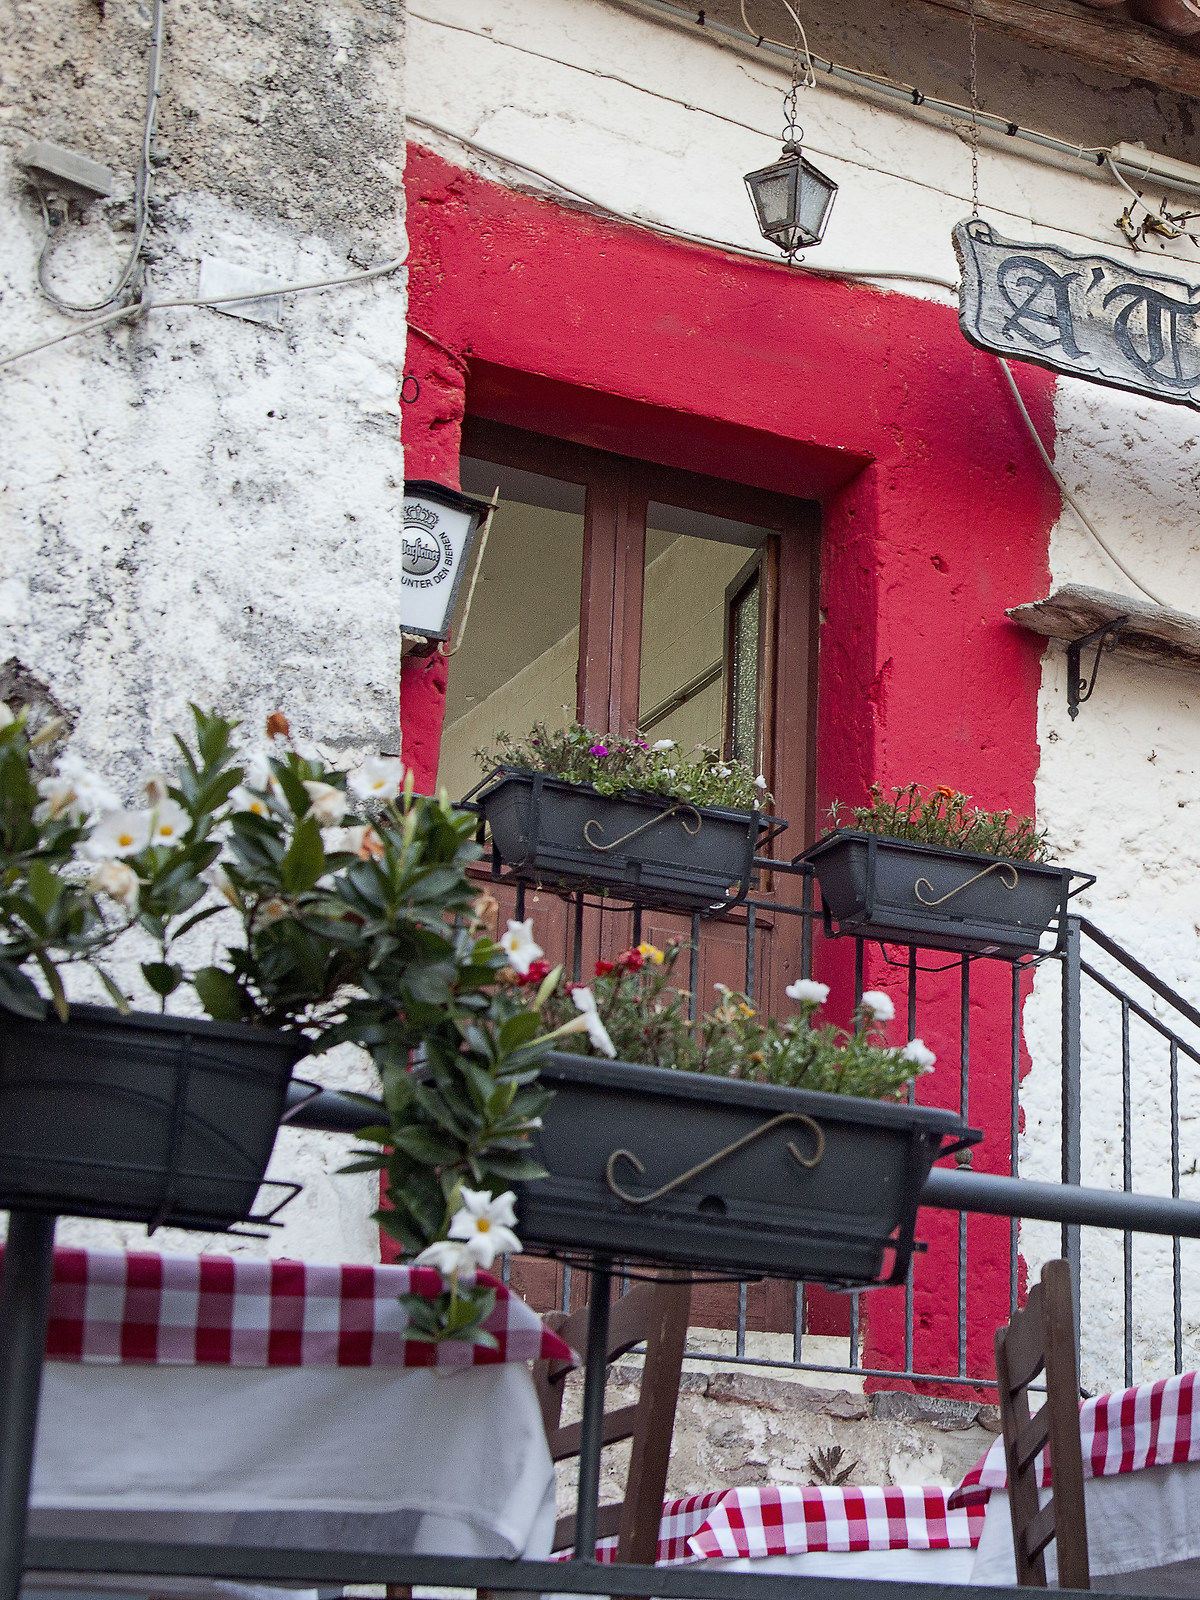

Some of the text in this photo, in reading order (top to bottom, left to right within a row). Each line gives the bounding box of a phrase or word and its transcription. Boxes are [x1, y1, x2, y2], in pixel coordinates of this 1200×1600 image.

[401, 531, 454, 589] UNTER DEN BIEREN
